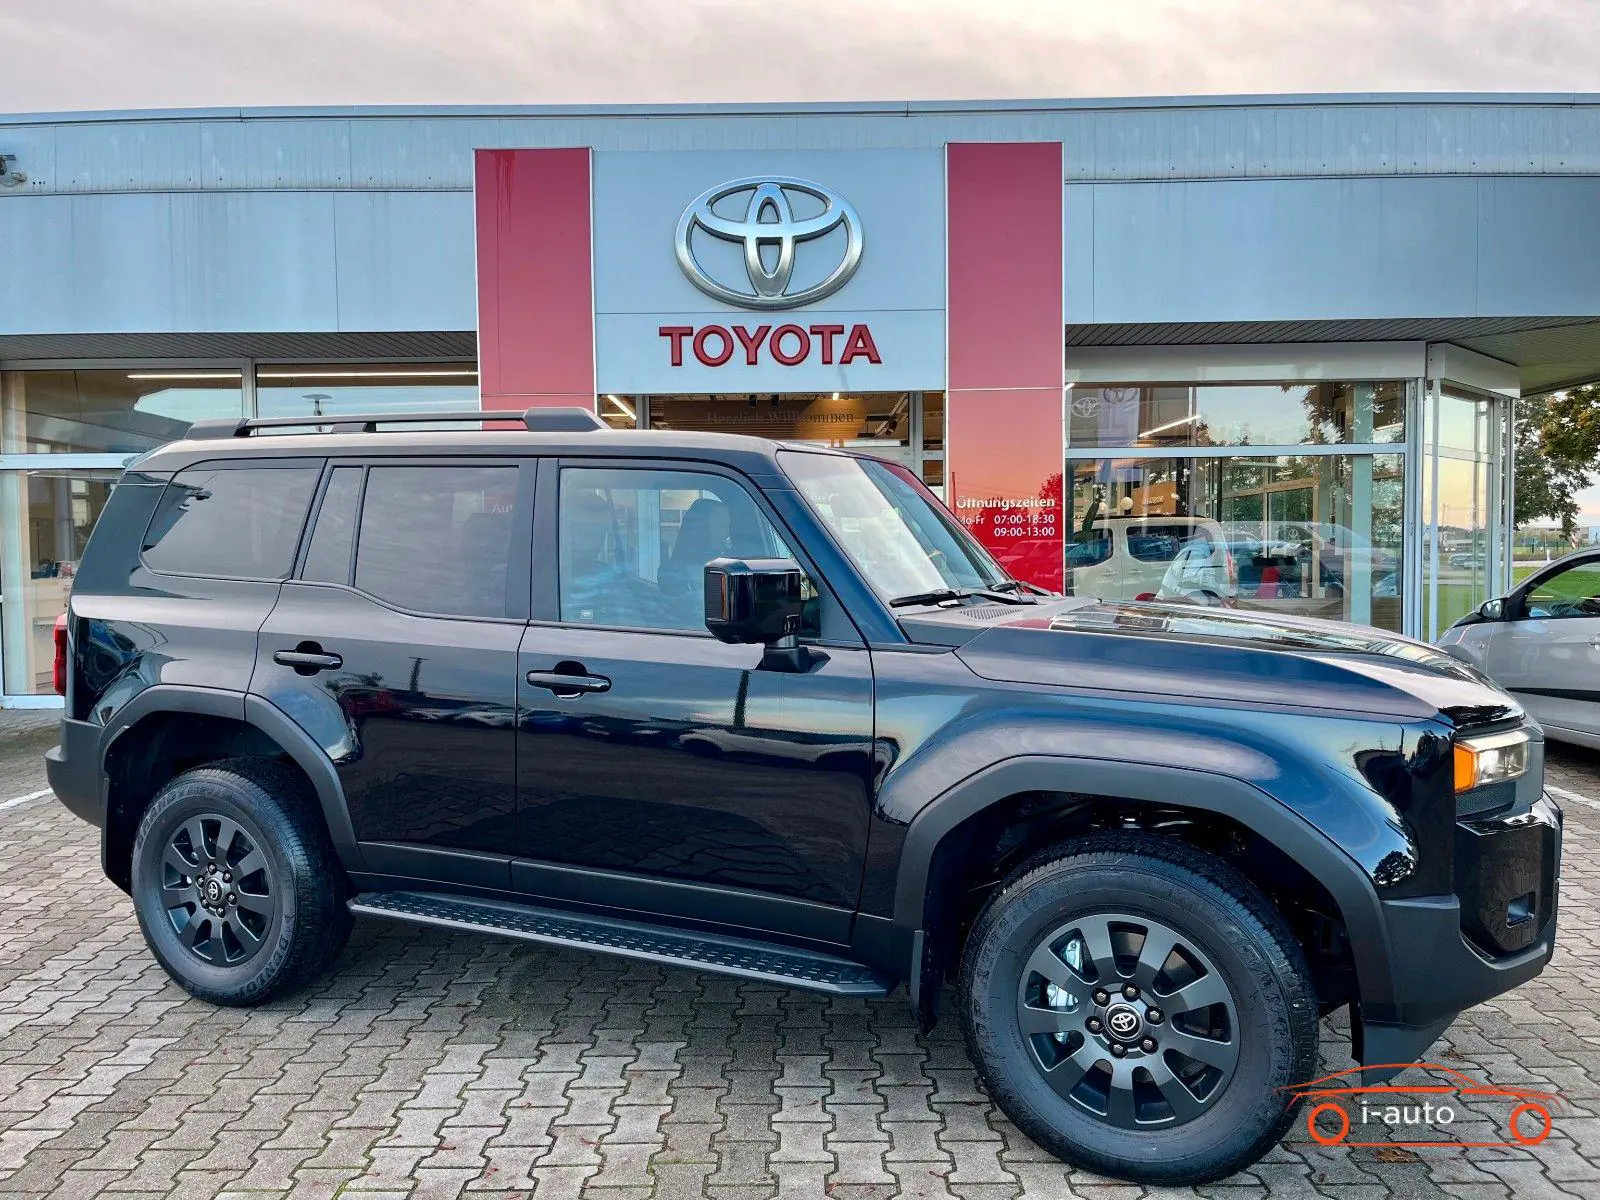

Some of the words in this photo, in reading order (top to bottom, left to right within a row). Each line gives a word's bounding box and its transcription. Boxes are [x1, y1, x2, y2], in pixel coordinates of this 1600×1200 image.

[659, 324, 882, 367] TOYOTA
[705, 411, 764, 424] Herzlich
[767, 410, 855, 424] Willkommen
[956, 496, 1055, 511] Öffnungszeiten
[994, 514, 1055, 525] 07:00-18:30
[994, 527, 1055, 537] 09:00-13:00
